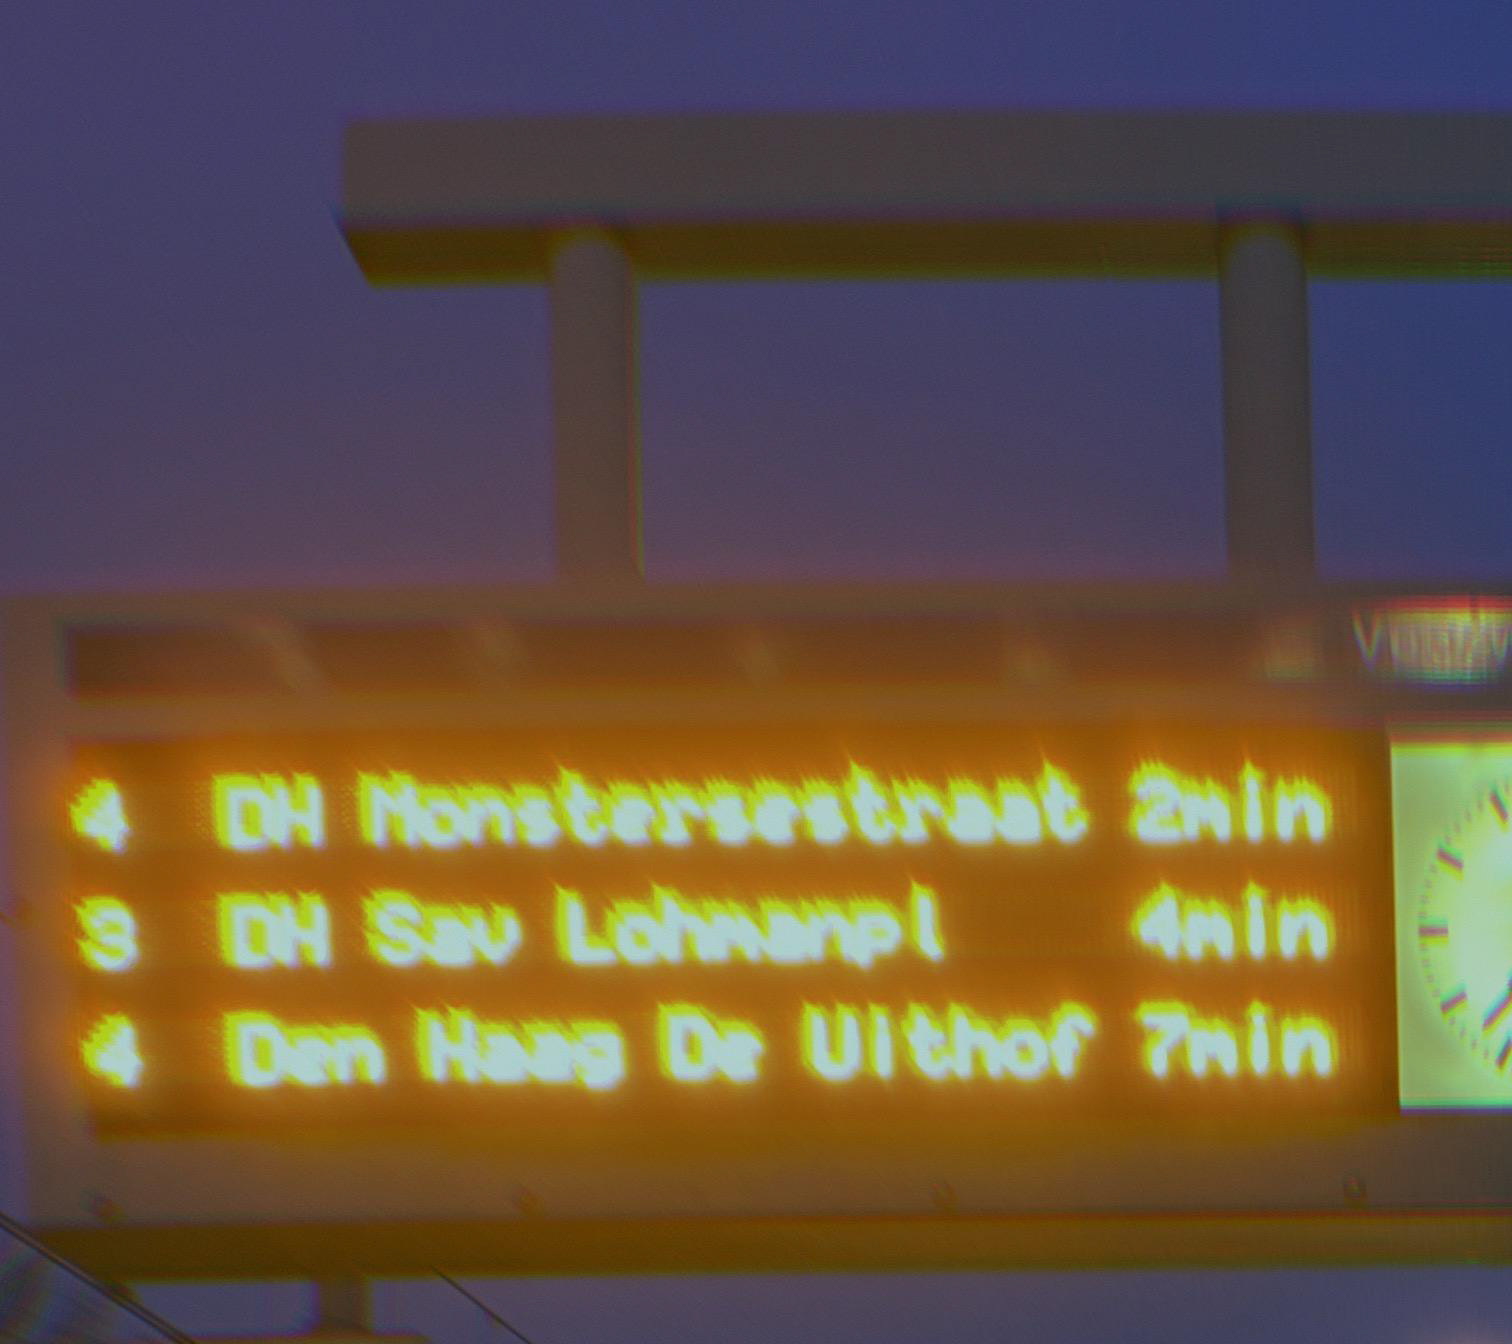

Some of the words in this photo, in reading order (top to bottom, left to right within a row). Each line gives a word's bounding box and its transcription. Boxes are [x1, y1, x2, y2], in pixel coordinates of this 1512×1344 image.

[70, 779, 130, 852] 4
[210, 772, 326, 852] DH
[354, 760, 1092, 851] Monstersestraat
[74, 896, 140, 972] 3
[215, 891, 334, 970] DH
[362, 888, 524, 969] Sav
[80, 1014, 145, 1088] 4
[221, 1010, 388, 1090] Den
[412, 1006, 630, 1091] Haag
[653, 1001, 768, 1086] De
[797, 999, 1098, 1085] Uithof
